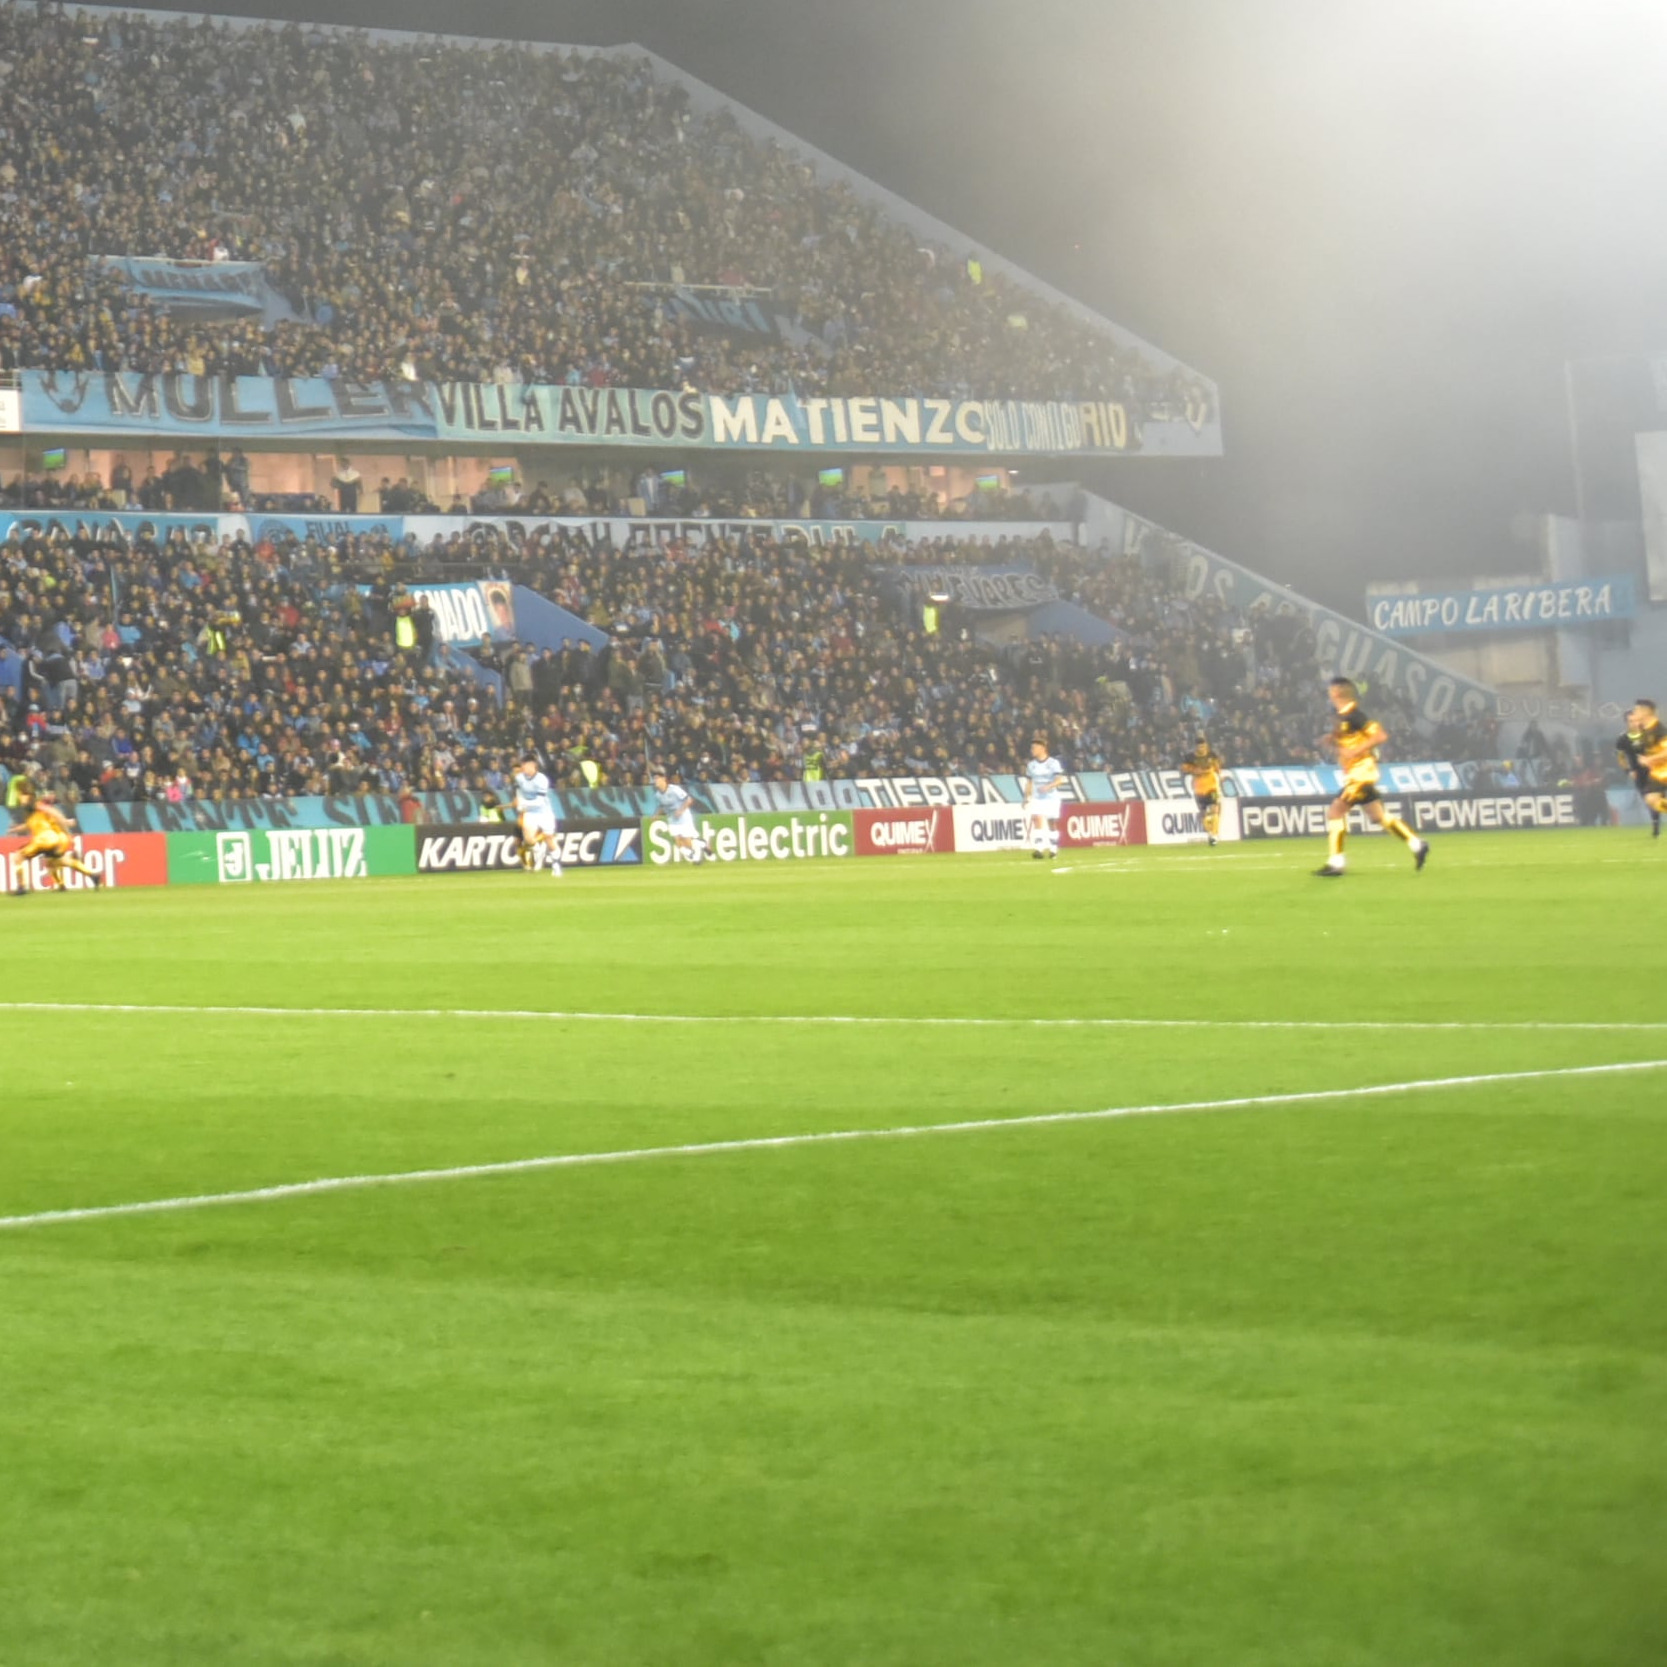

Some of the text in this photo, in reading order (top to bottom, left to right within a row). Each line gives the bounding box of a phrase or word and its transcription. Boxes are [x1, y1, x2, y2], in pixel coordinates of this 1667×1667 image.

[436, 383, 705, 439] VILLA AVALOS
[708, 394, 986, 444] MATIENZO
[1373, 596, 1459, 631] CAMPO
[870, 809, 938, 853] QUIMEX
[1067, 804, 1131, 846] QUIMEX
[1417, 793, 1575, 829] POWERADE
[417, 830, 601, 869] KARTOSEC
